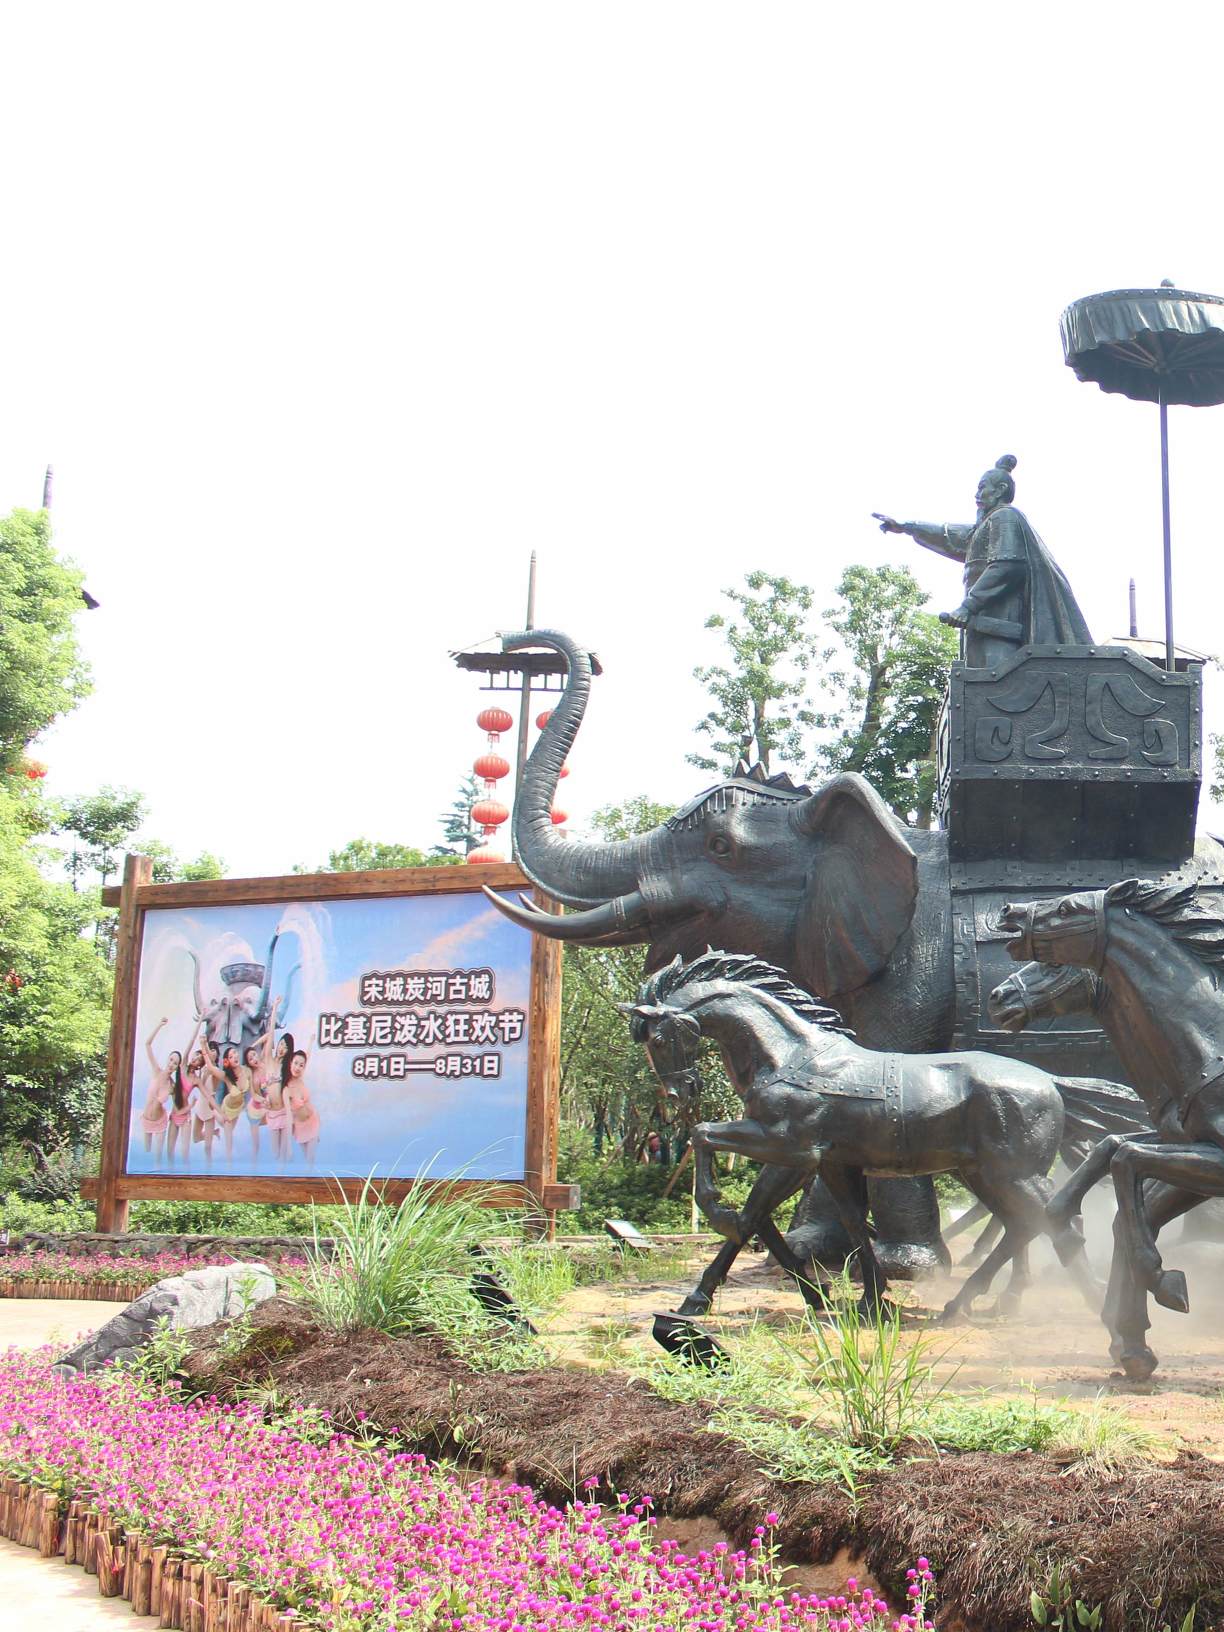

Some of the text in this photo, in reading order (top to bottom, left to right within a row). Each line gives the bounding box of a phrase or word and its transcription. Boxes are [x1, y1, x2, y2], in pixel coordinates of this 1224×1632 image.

[363, 974, 491, 1002] 宋城炭河古城
[320, 1012, 524, 1045] 比基尼泼水狂欢节
